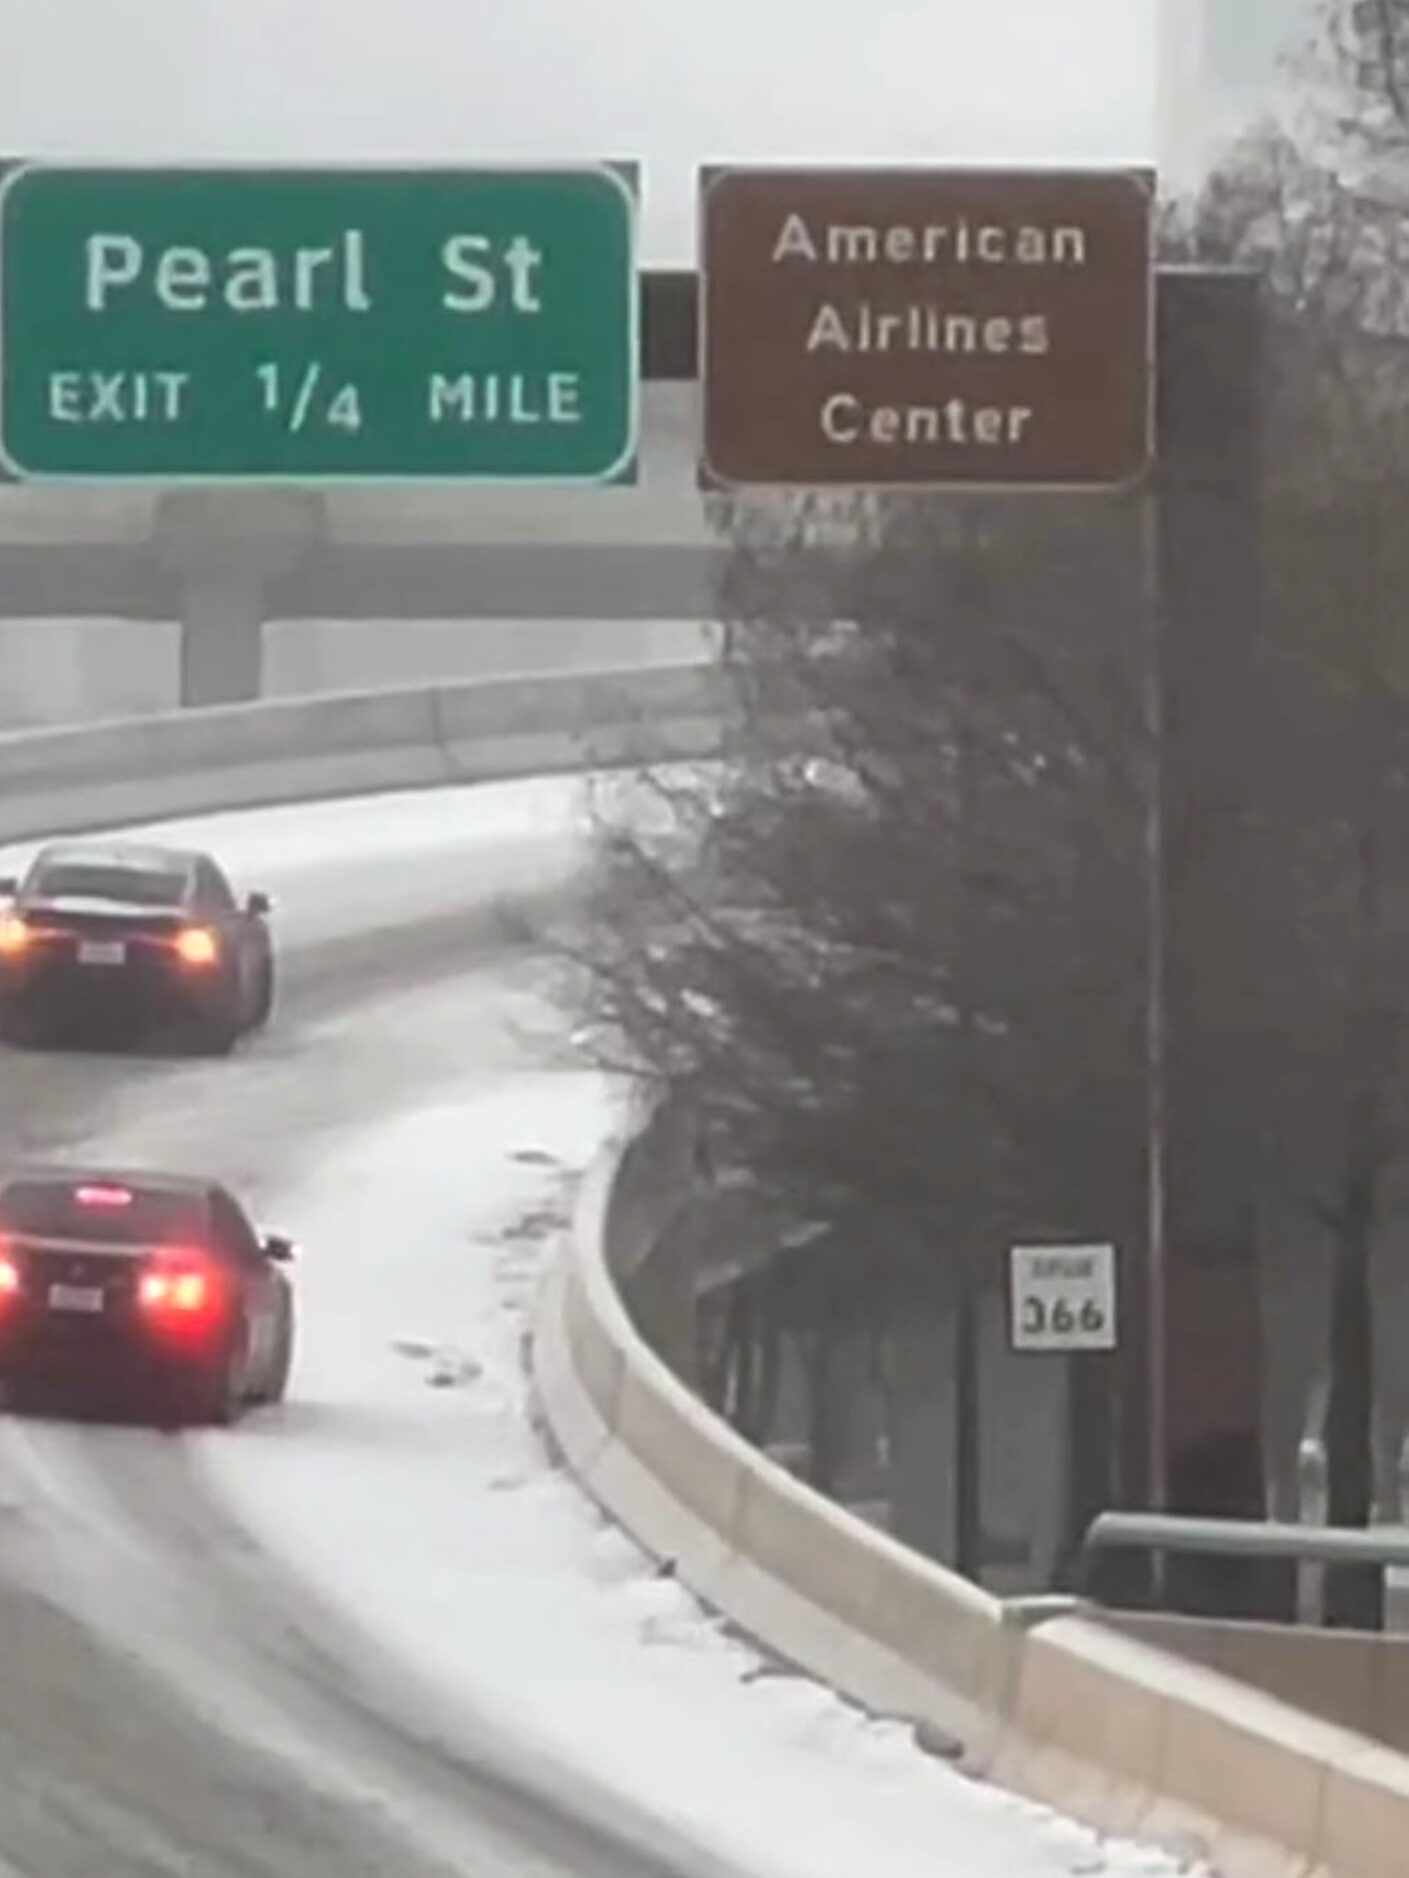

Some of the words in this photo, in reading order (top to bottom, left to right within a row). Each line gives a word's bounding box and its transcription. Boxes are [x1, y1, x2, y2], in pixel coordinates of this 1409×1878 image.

[771, 212, 1087, 264] American
[85, 229, 372, 312] Pearl
[441, 234, 543, 312] St
[806, 303, 1049, 353] Airlines
[48, 371, 190, 422] EXIT
[255, 361, 362, 433] 1/4
[428, 373, 582, 423] MILE
[820, 393, 1033, 444] Center
